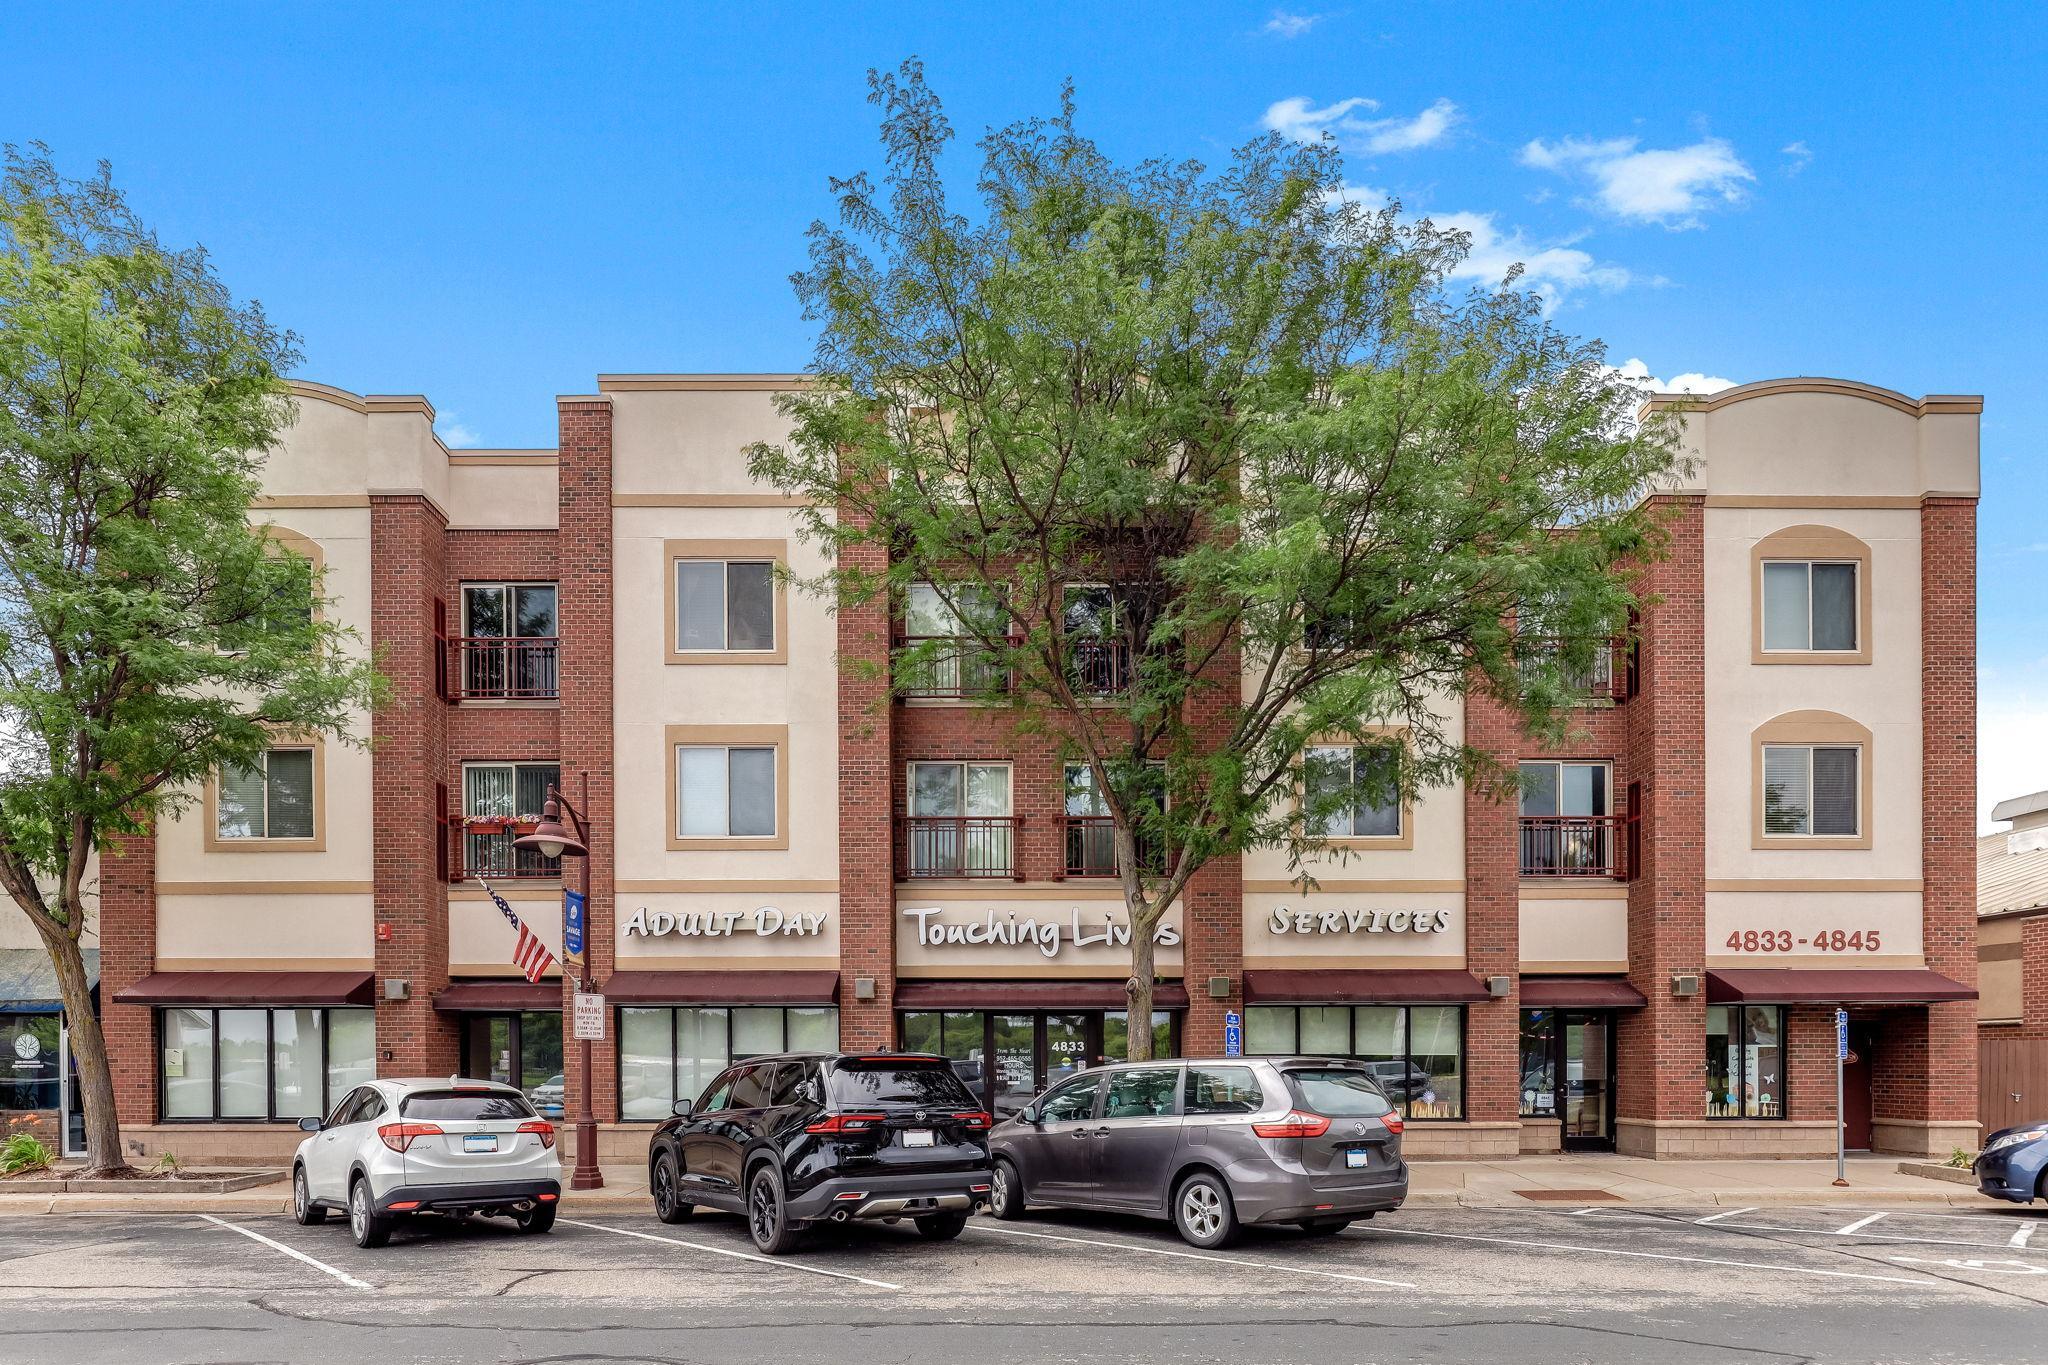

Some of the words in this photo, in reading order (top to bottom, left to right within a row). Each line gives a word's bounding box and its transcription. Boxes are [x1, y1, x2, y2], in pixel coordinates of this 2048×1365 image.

[754, 905, 827, 937] DAY
[1268, 903, 1452, 935] SERVICES
[902, 907, 1060, 958] Touching
[1072, 906, 1181, 947] Livs
[577, 1006, 602, 1015] PARKING
[585, 997, 594, 1006] NO
[1051, 1041, 1085, 1052] 4833
